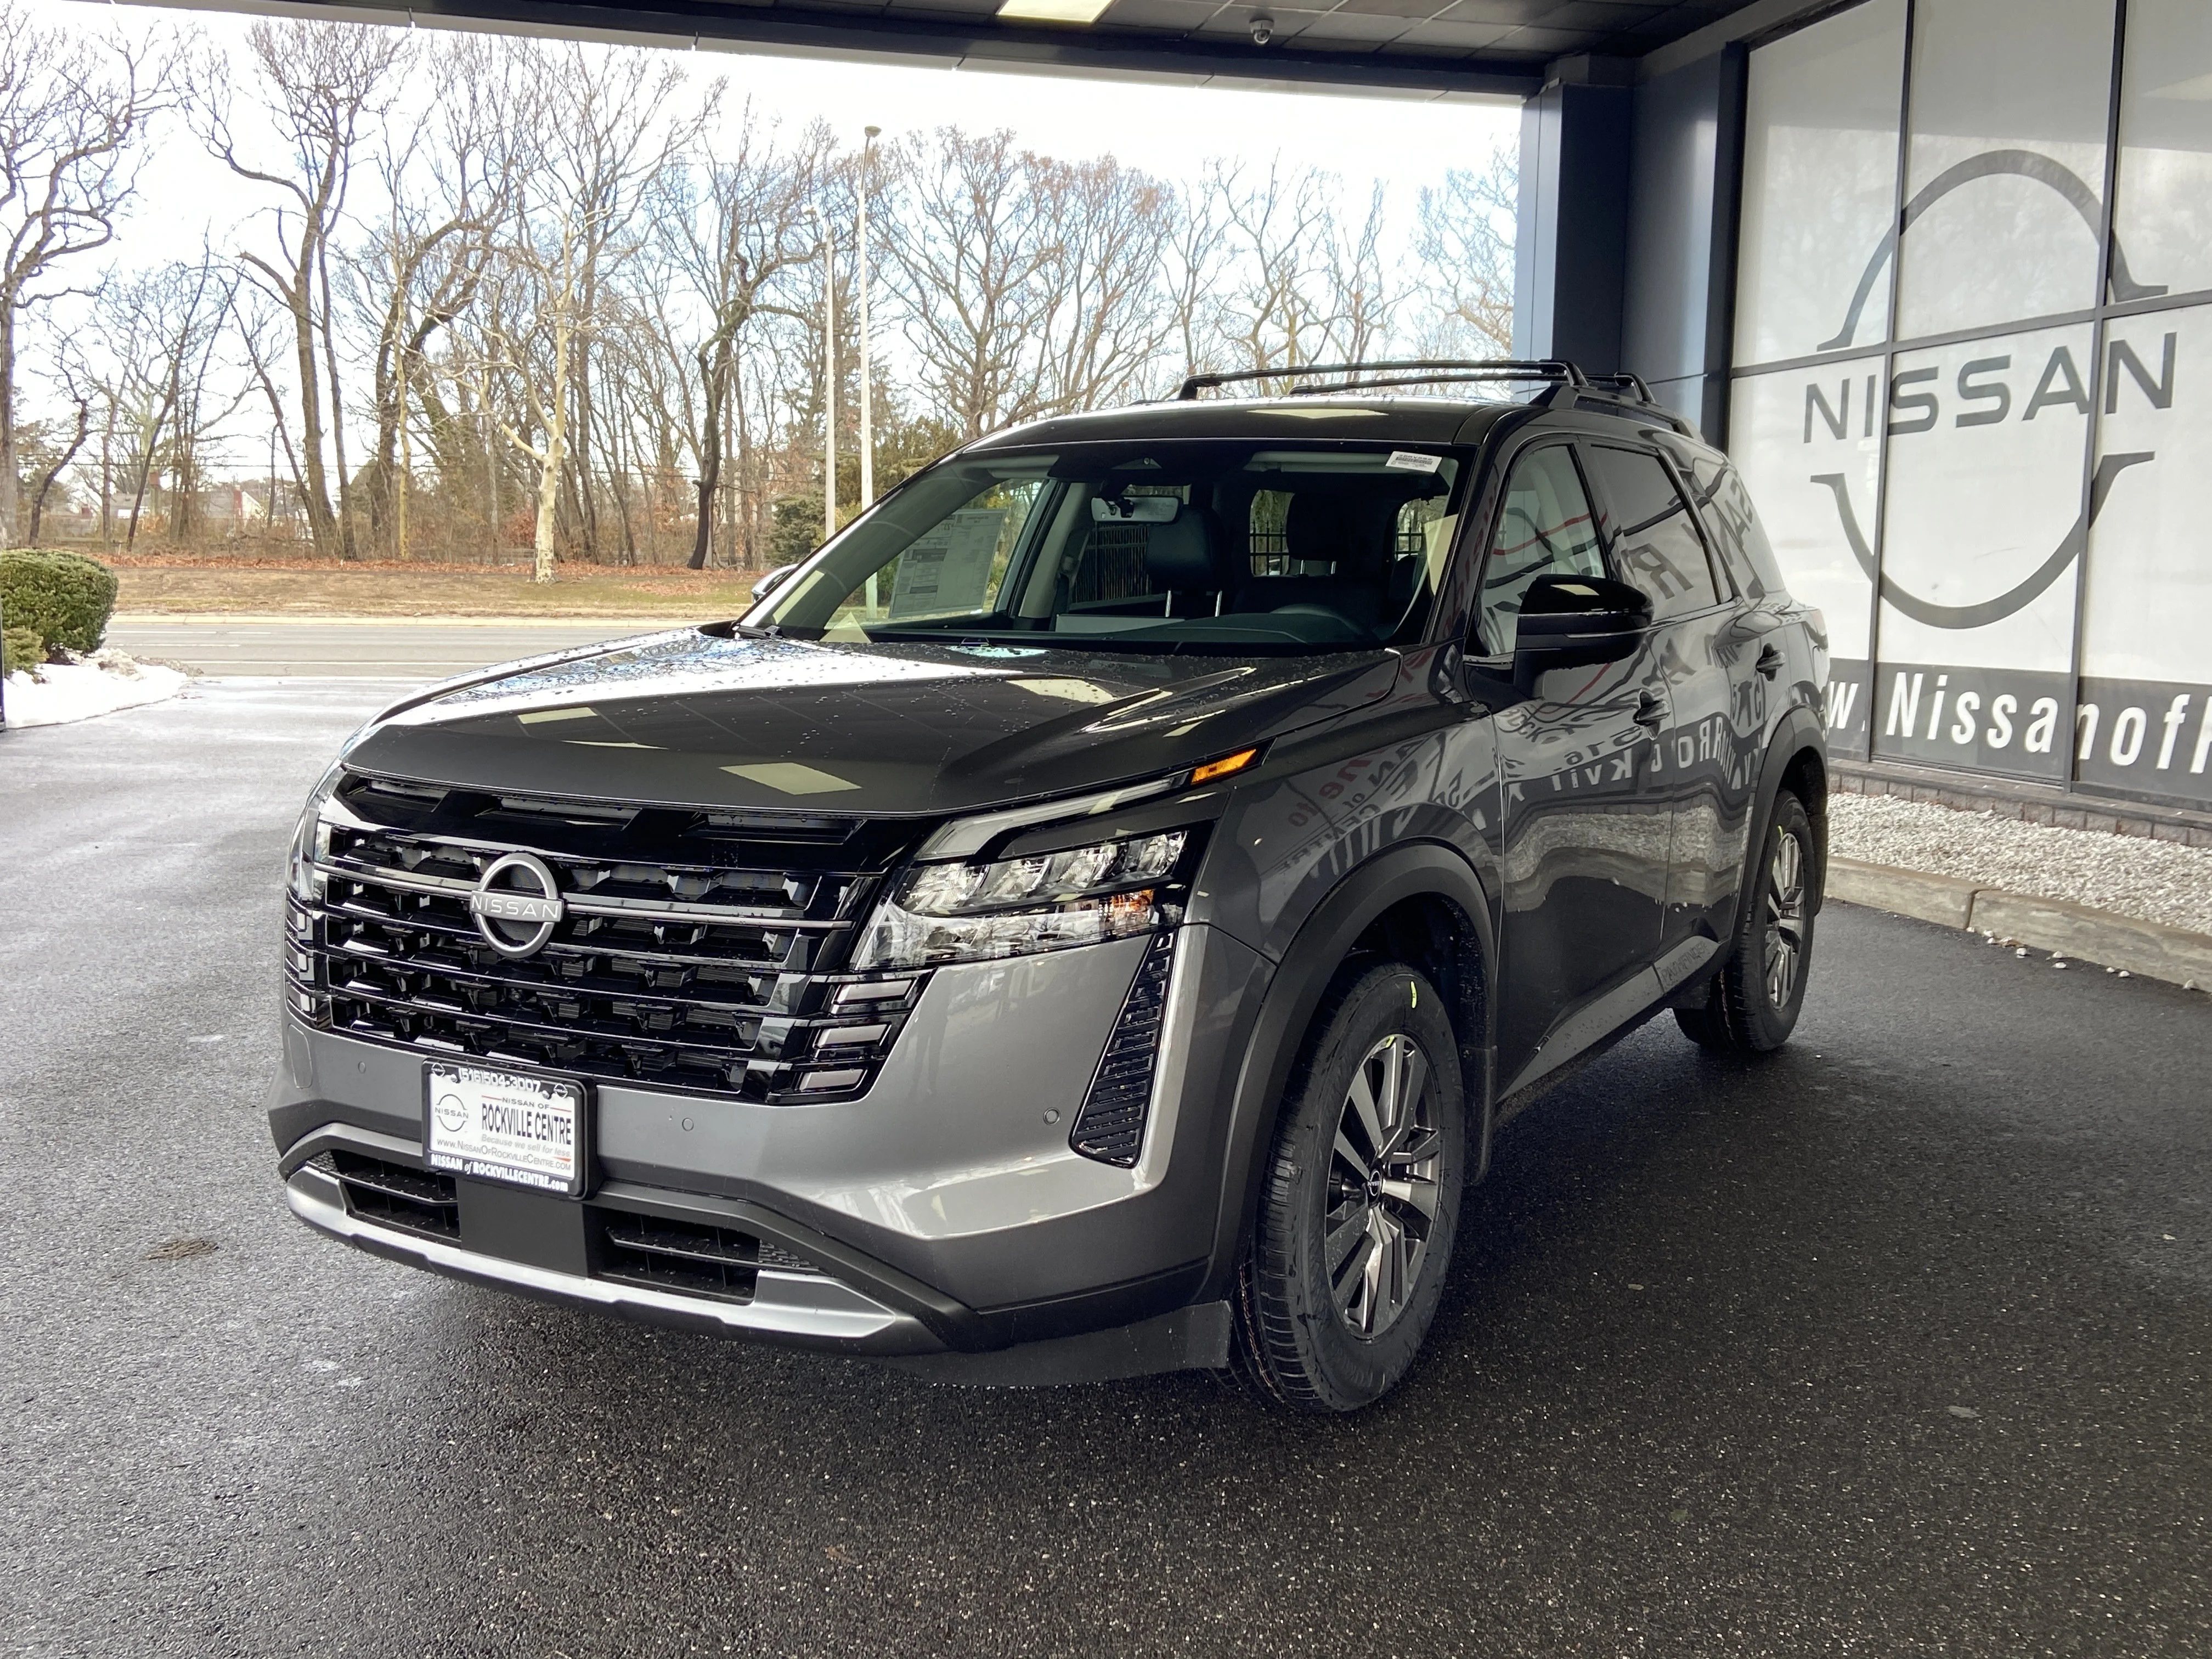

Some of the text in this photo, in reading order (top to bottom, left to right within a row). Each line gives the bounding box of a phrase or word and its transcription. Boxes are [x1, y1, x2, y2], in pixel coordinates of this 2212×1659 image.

[1804, 332, 2177, 443] NISSAN
[472, 895, 558, 919] NISSAN
[435, 1107, 469, 1119] NISSAN
[503, 1097, 534, 1107] NISSAN
[482, 1103, 571, 1145] ROCKVILLE CENTRE
[481, 1133, 513, 1147] Because
[515, 1142, 526, 1150] we
[527, 1142, 541, 1151] sell
[543, 1144, 553, 1154] for
[431, 1153, 568, 1192] NISSAN of ROCKVILLECENTRE.com
